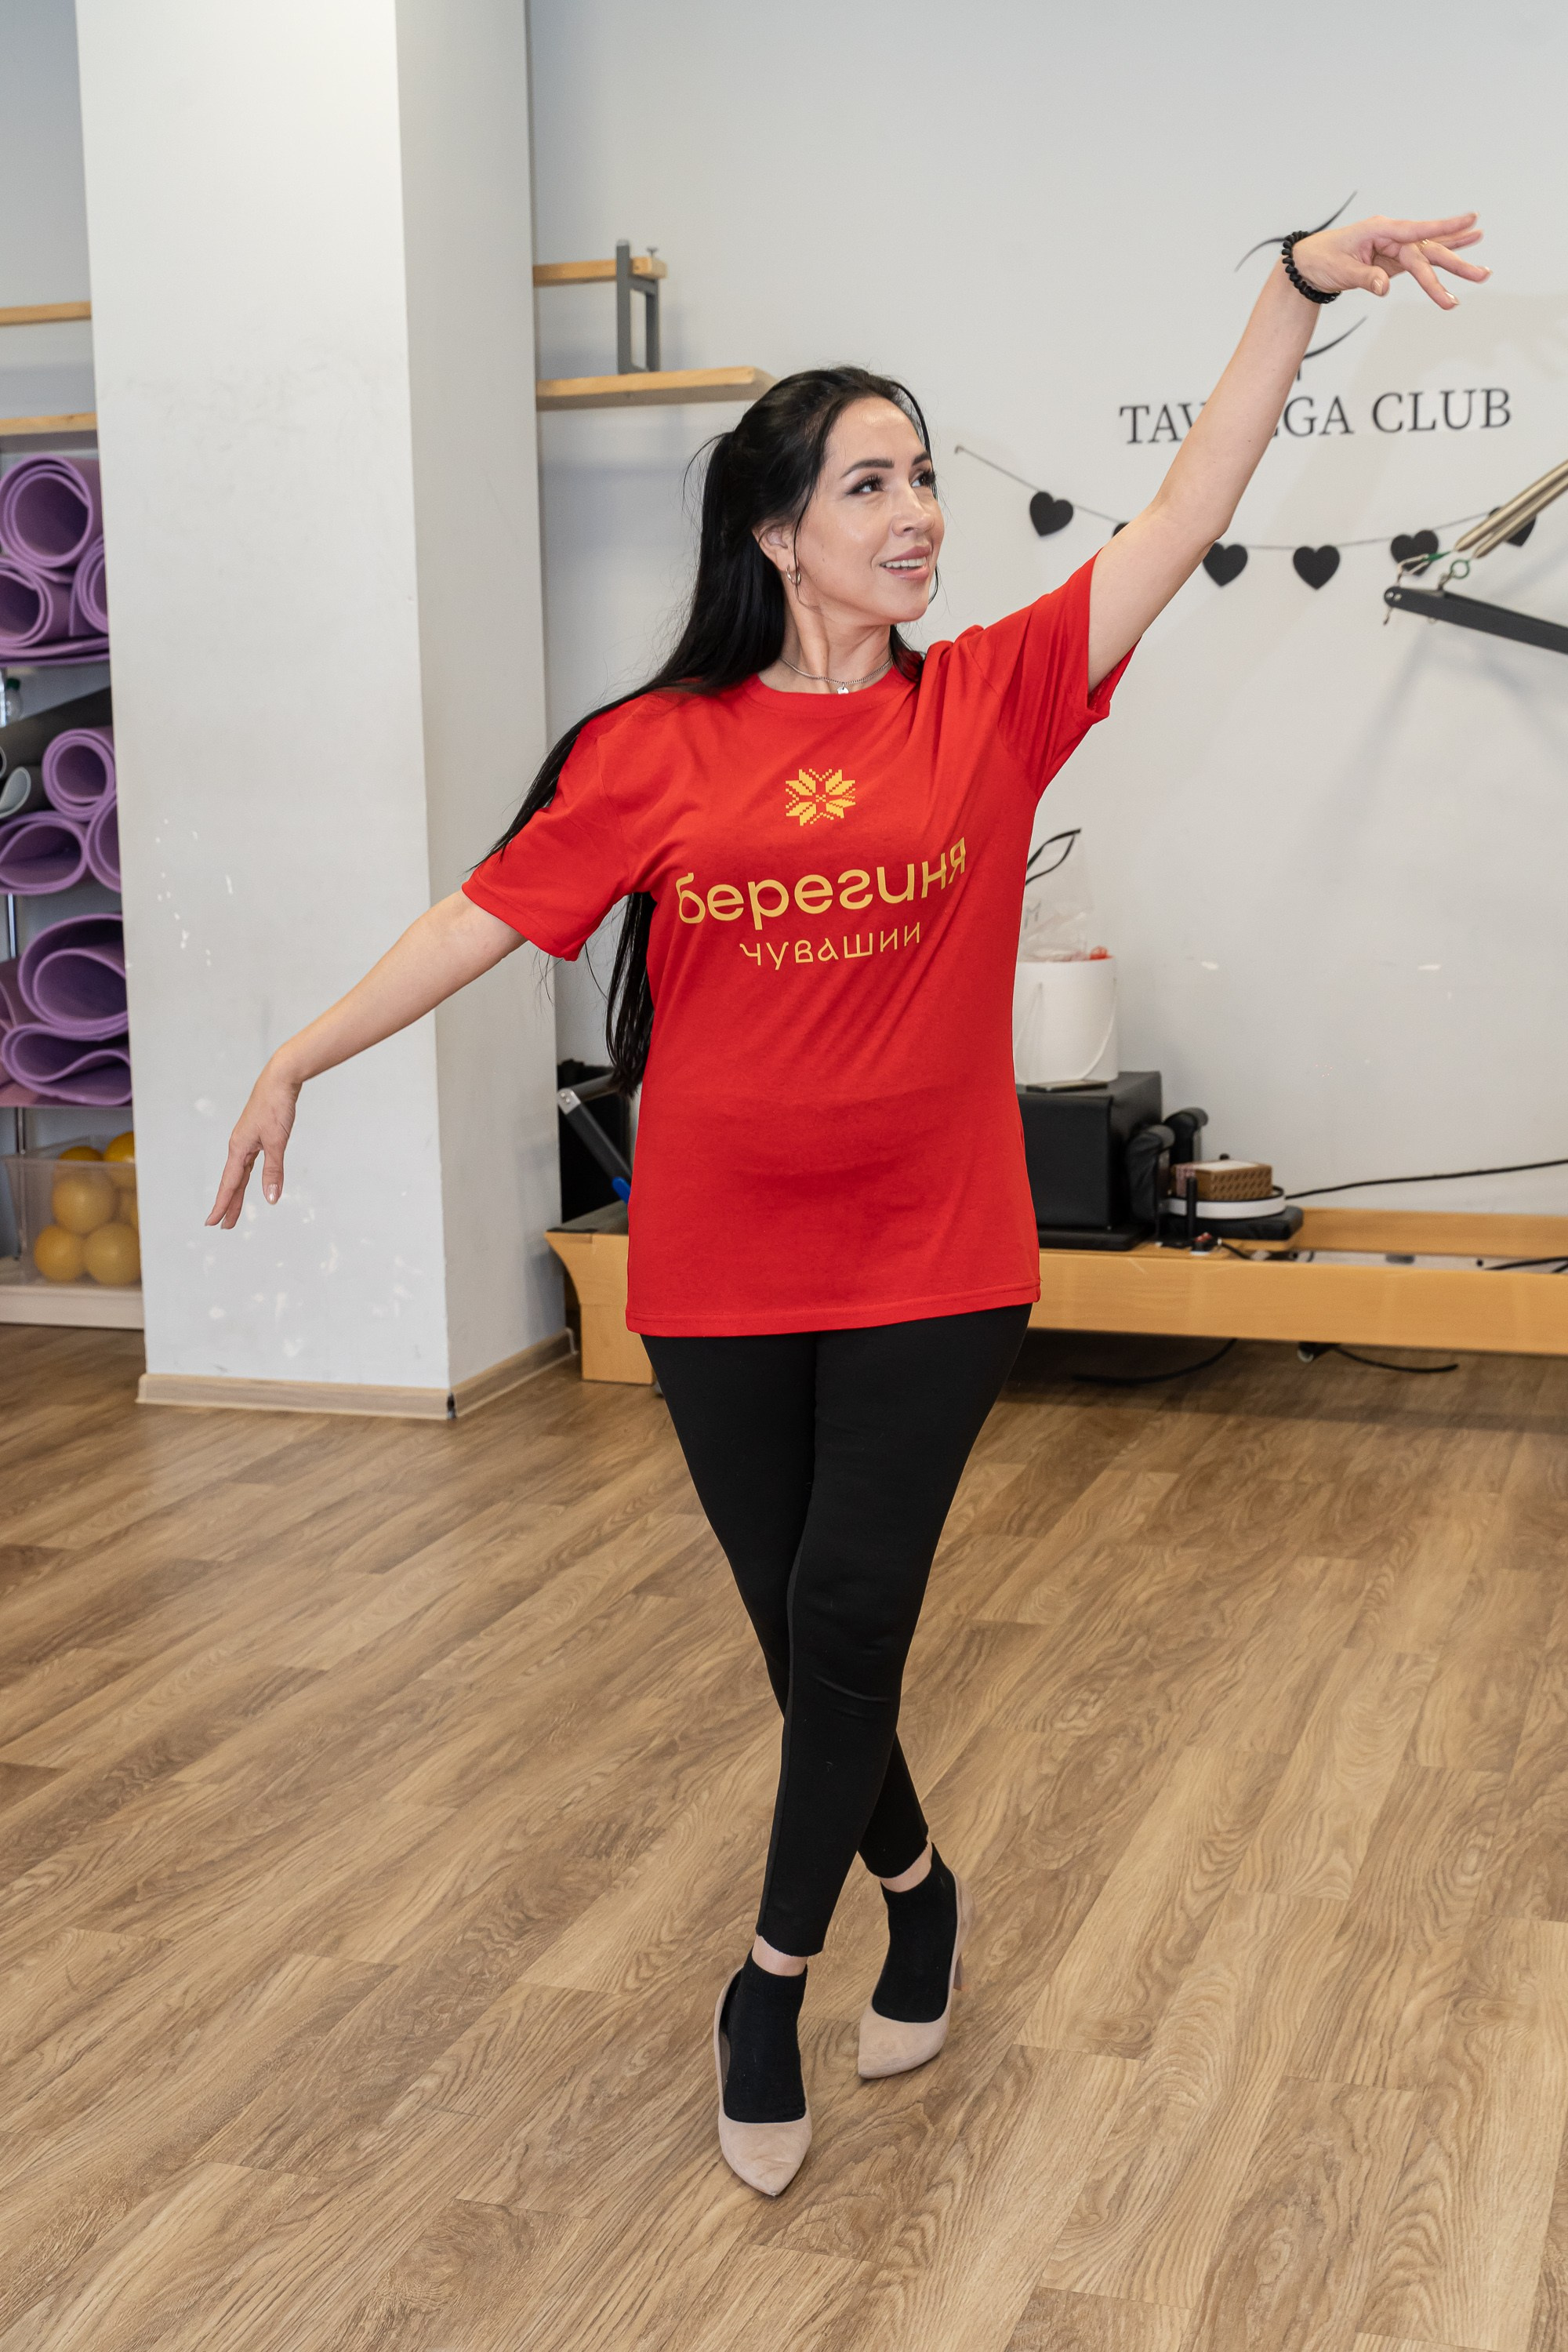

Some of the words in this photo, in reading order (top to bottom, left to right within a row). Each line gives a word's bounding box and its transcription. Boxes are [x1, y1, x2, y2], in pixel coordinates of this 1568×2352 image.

[1119, 395, 1355, 445] TAVGA
[1371, 387, 1512, 434] CLUB
[675, 837, 967, 931] берегиня
[739, 921, 920, 971] чувашии
